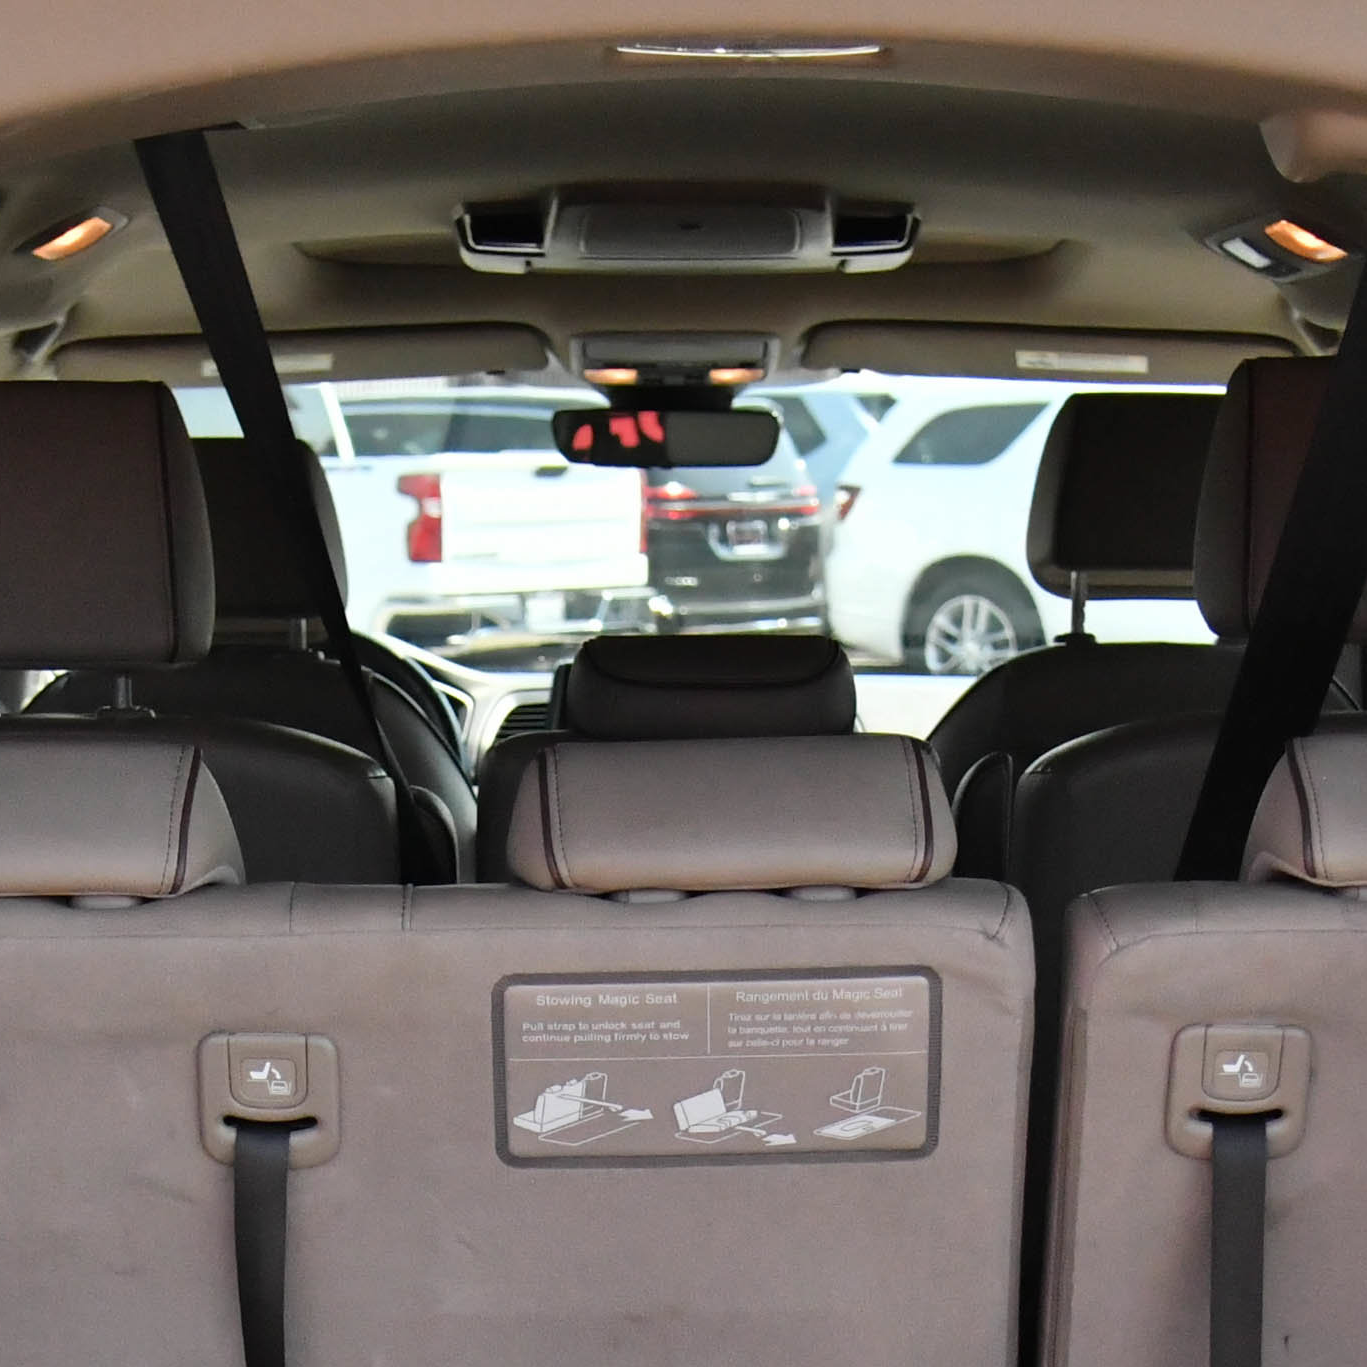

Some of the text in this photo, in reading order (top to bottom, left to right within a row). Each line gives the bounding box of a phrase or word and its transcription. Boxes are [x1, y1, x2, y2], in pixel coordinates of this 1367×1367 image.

[535, 992, 679, 1008] Stowing Magic Seat
[736, 987, 903, 1005] Rangement du Magic Seat
[522, 1019, 682, 1033] Pull strap to unlock seat and
[522, 1030, 690, 1045] continue pulling firmly to stow
